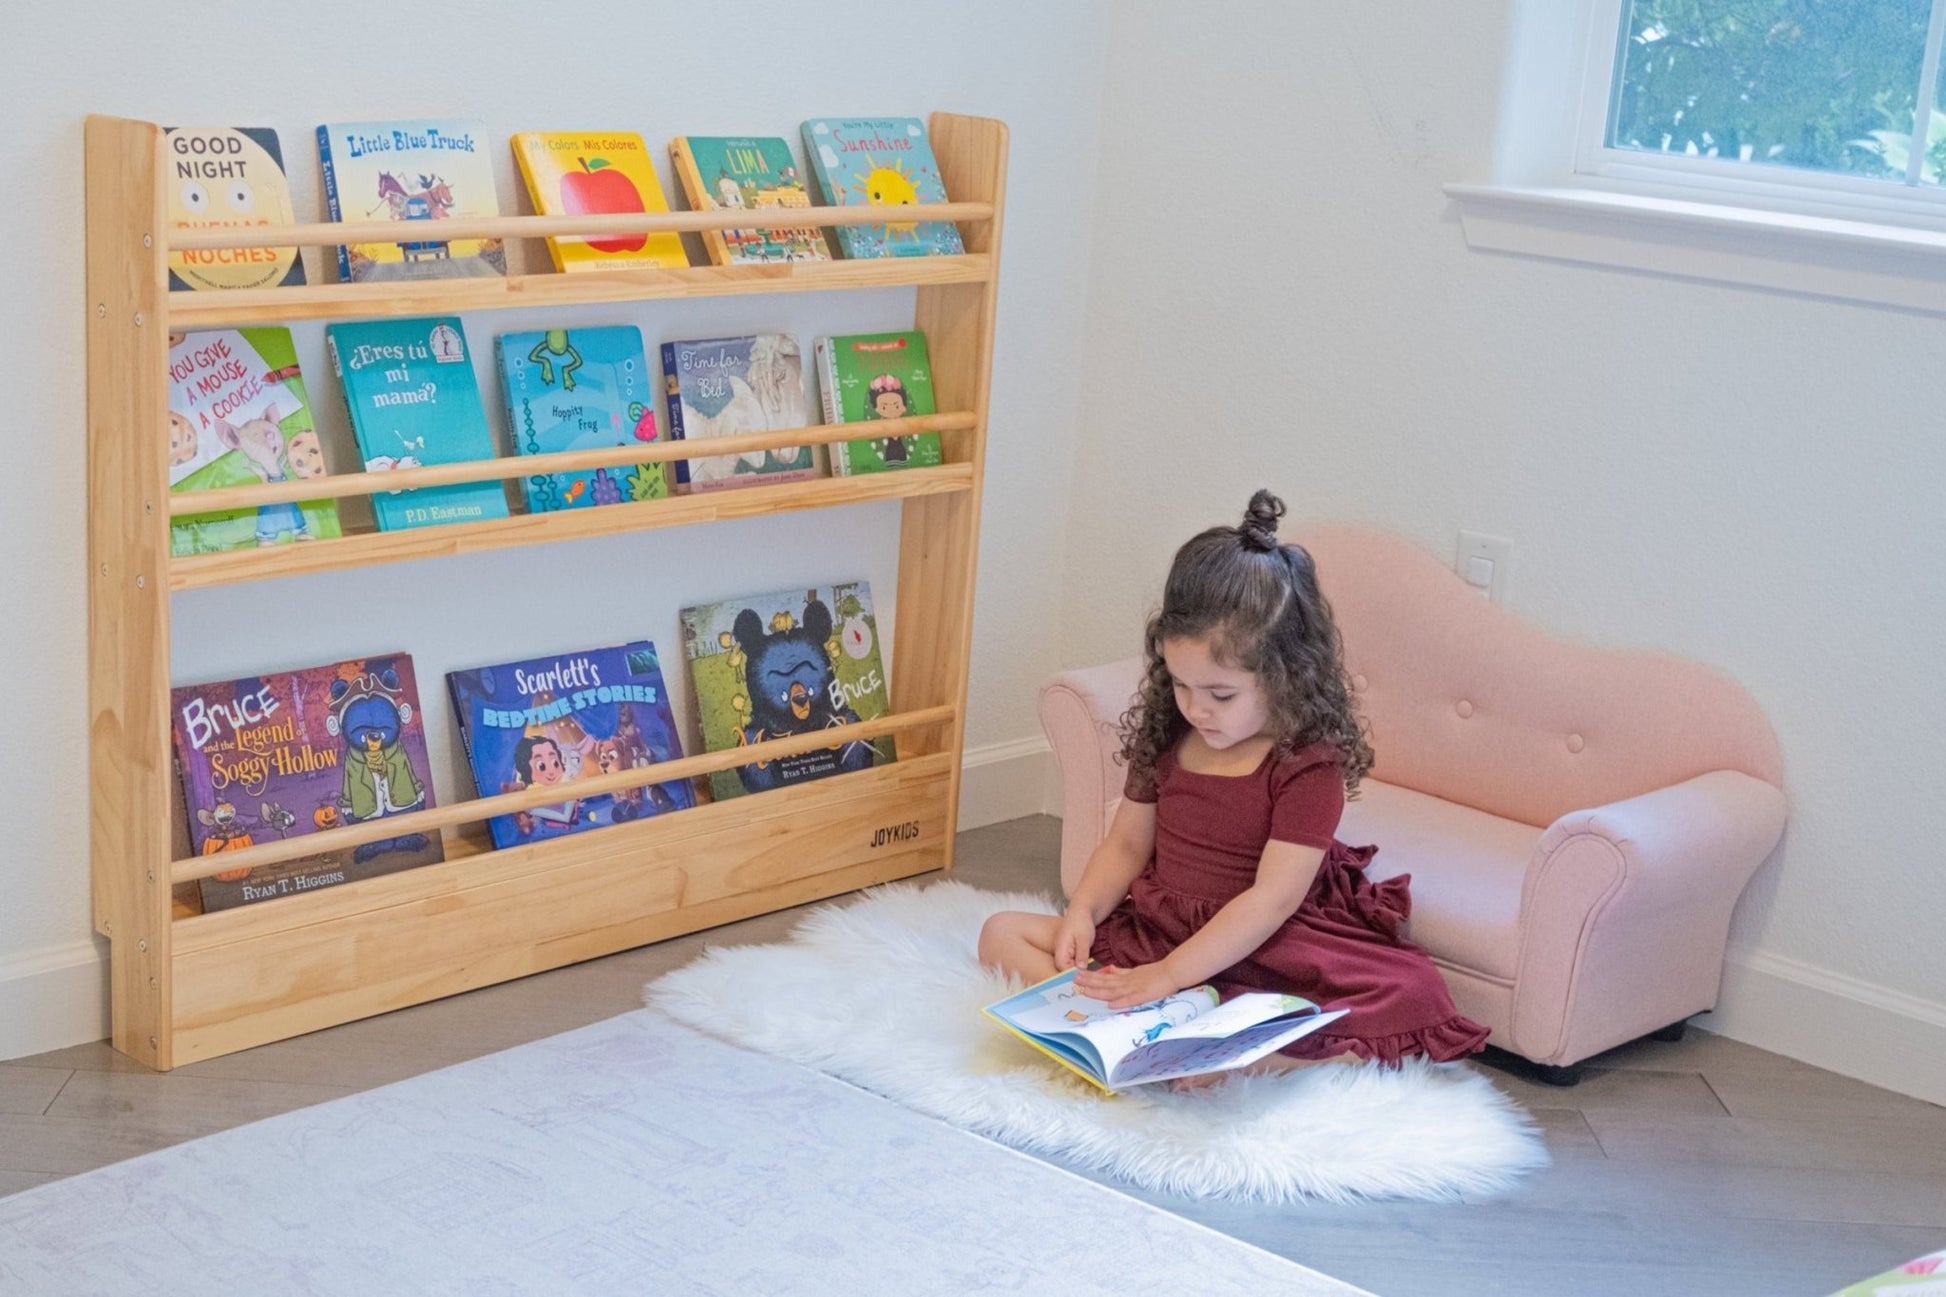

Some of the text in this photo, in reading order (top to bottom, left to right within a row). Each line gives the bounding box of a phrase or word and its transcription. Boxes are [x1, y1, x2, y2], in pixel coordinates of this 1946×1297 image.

[173, 137, 242, 155] GOOD
[347, 134, 391, 158] Little
[392, 130, 427, 151] Blue
[427, 128, 475, 153] Truck
[548, 139, 578, 151] Colors
[583, 138, 601, 151] Mis
[602, 137, 638, 151] Colores
[833, 129, 912, 153] Sunshine
[176, 160, 247, 179] NIGHT
[726, 148, 770, 174] LIMA
[182, 246, 277, 264] NOCHES
[169, 338, 232, 384] YOU GIVE
[349, 343, 404, 369] ¿Eres
[409, 340, 429, 361] tú
[681, 350, 718, 371] Time
[718, 348, 743, 377] for
[186, 359, 248, 406] A MOUSE
[384, 363, 410, 383] mi
[372, 381, 438, 408] mamá?
[697, 377, 725, 398] Bed
[199, 376, 264, 430] A COOKIE
[552, 404, 583, 422] Hoppity
[578, 418, 598, 434] Frog
[432, 504, 483, 521] Eastman
[515, 658, 601, 695] Scarlett's
[483, 684, 657, 729] BEDTIME STORIES
[203, 741, 219, 753] and
[220, 741, 235, 751] the
[235, 716, 295, 756] Legend
[211, 753, 270, 797] Soggy
[271, 744, 338, 776] Hollow
[870, 820, 919, 848] JOYKIDS
[242, 871, 345, 901] RYAN T. HIGGINS
